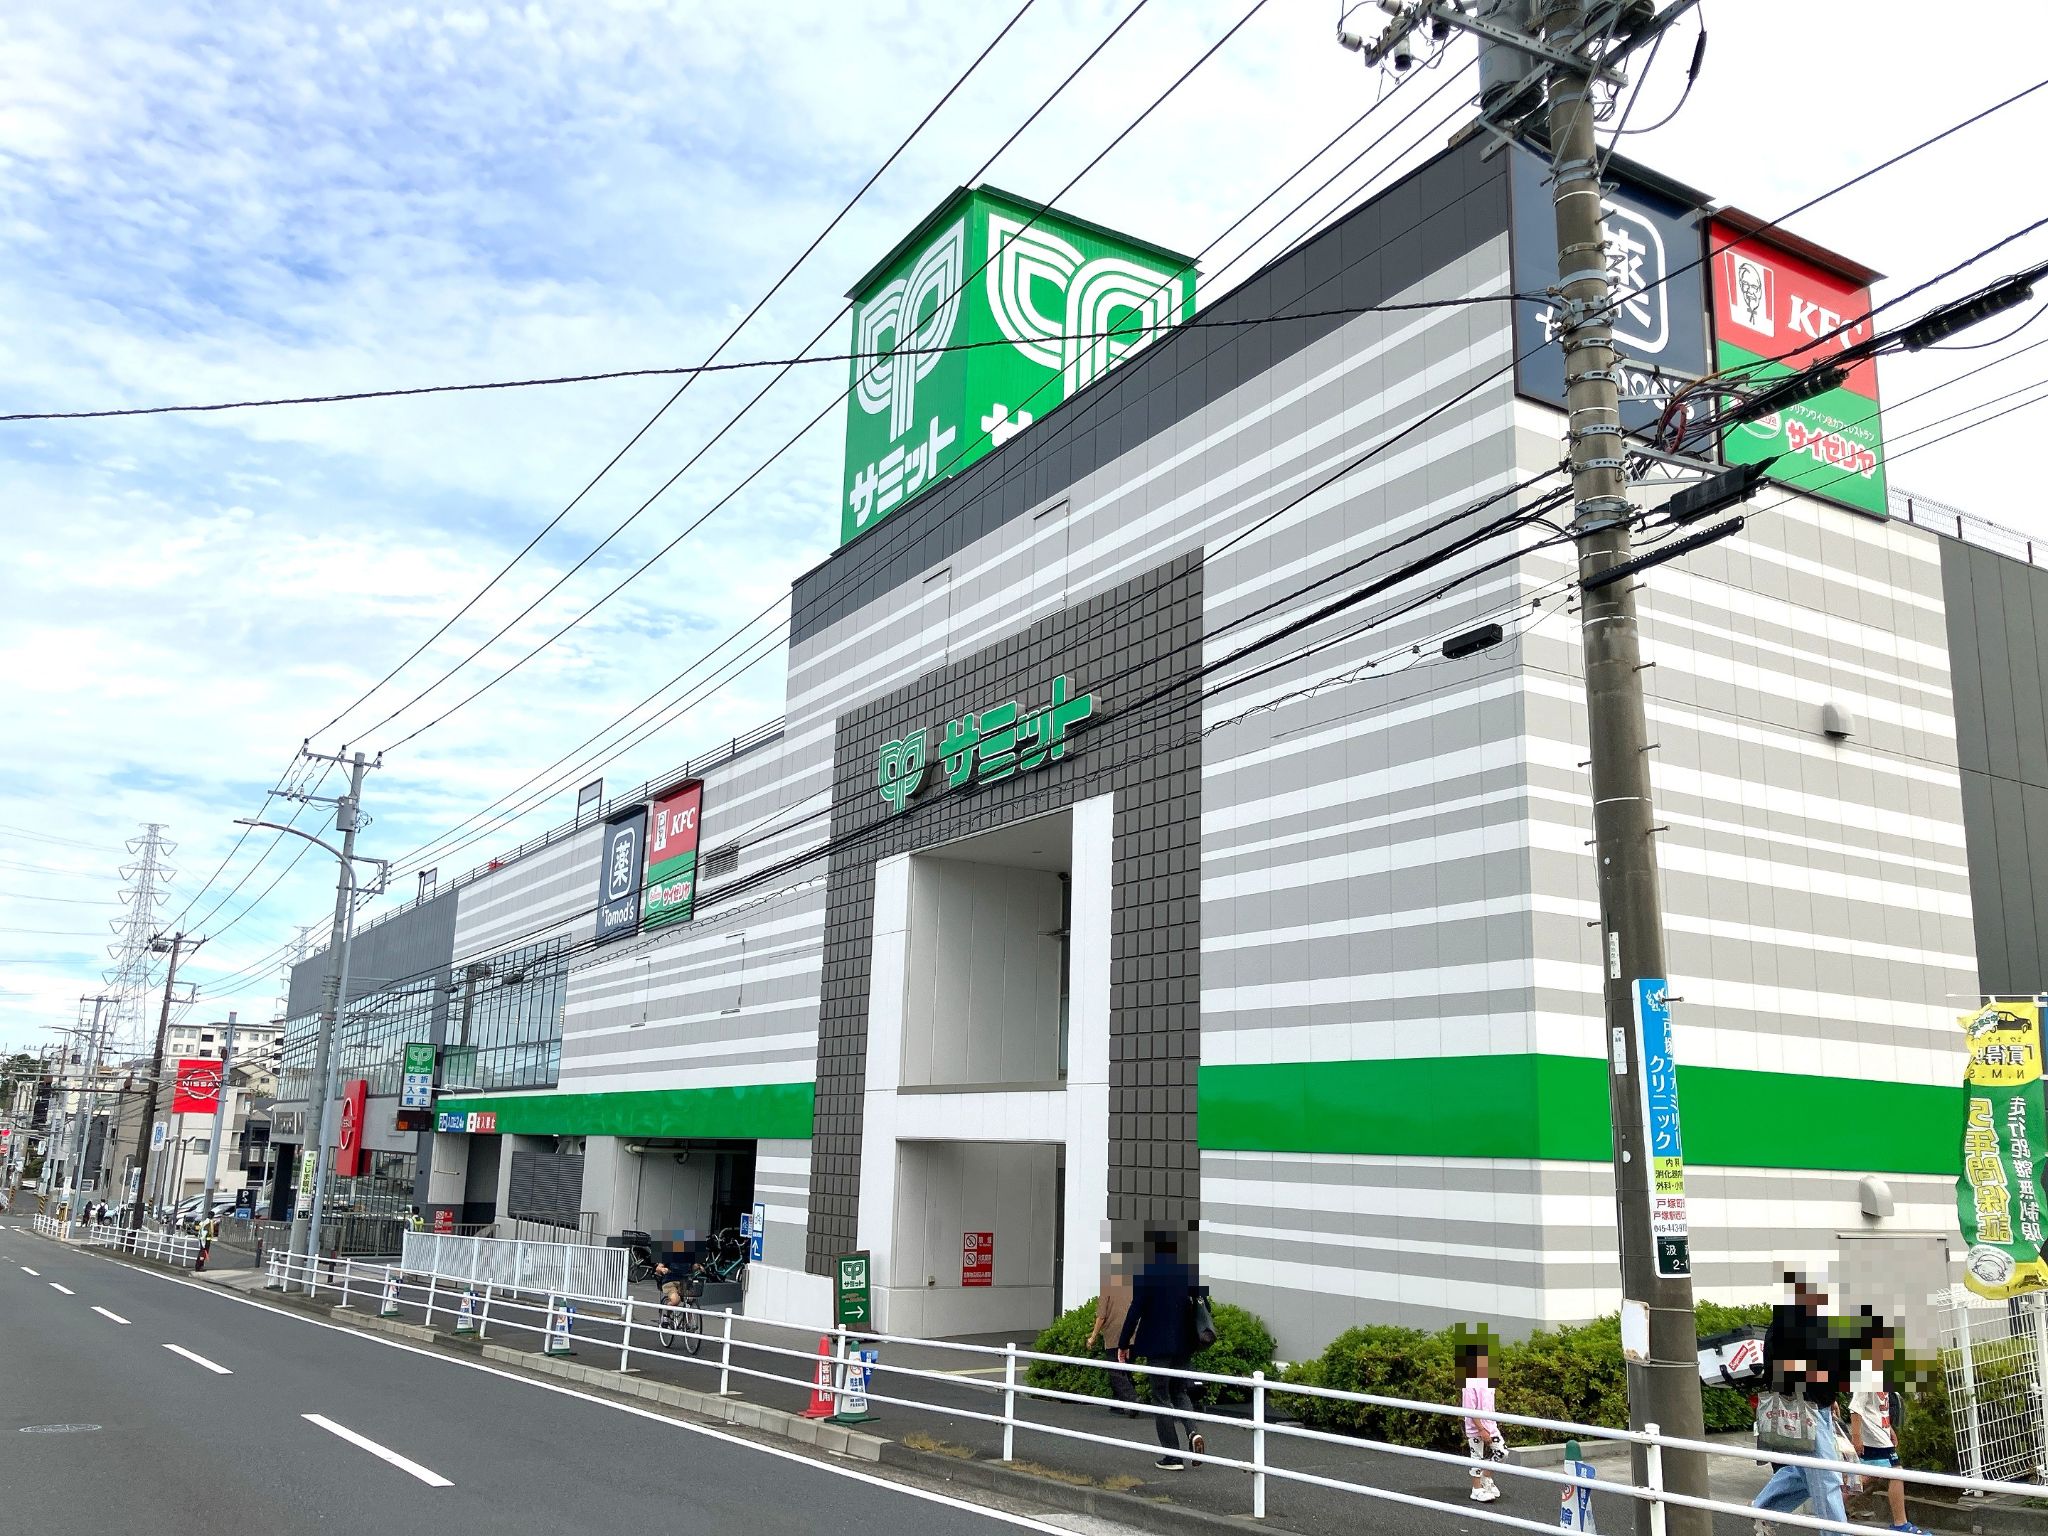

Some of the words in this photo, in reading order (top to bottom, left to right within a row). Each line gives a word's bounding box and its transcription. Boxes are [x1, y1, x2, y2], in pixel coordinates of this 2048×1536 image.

[1788, 294, 1863, 350] KFC
[850, 416, 957, 528] サミット
[1785, 418, 1877, 480] サイゼリヤ
[939, 674, 1093, 788] サミット
[671, 807, 696, 837] KFC
[612, 840, 631, 888] 薬
[602, 898, 634, 928] Tomod's
[407, 1065, 431, 1073] サミット
[408, 1075, 429, 1084] 右折
[1650, 1055, 1671, 1150] クリニック
